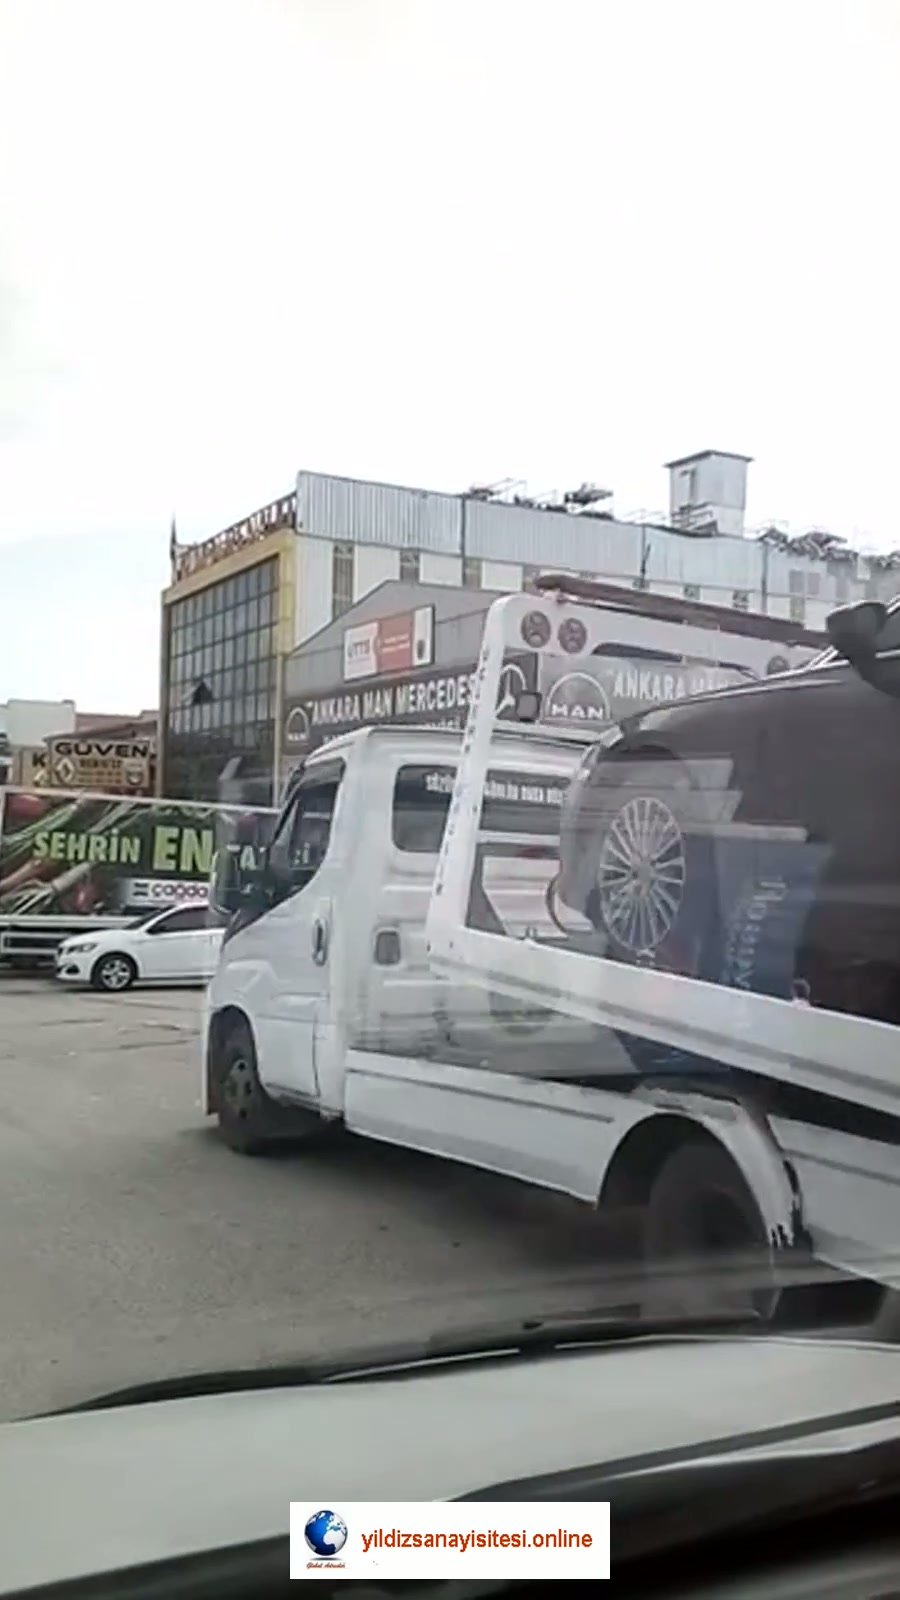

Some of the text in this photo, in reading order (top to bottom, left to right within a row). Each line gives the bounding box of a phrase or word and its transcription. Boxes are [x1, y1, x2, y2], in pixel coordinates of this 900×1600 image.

[550, 703, 604, 719] MAN
[55, 739, 148, 758] GÜVEN
[153, 825, 214, 873] EN
